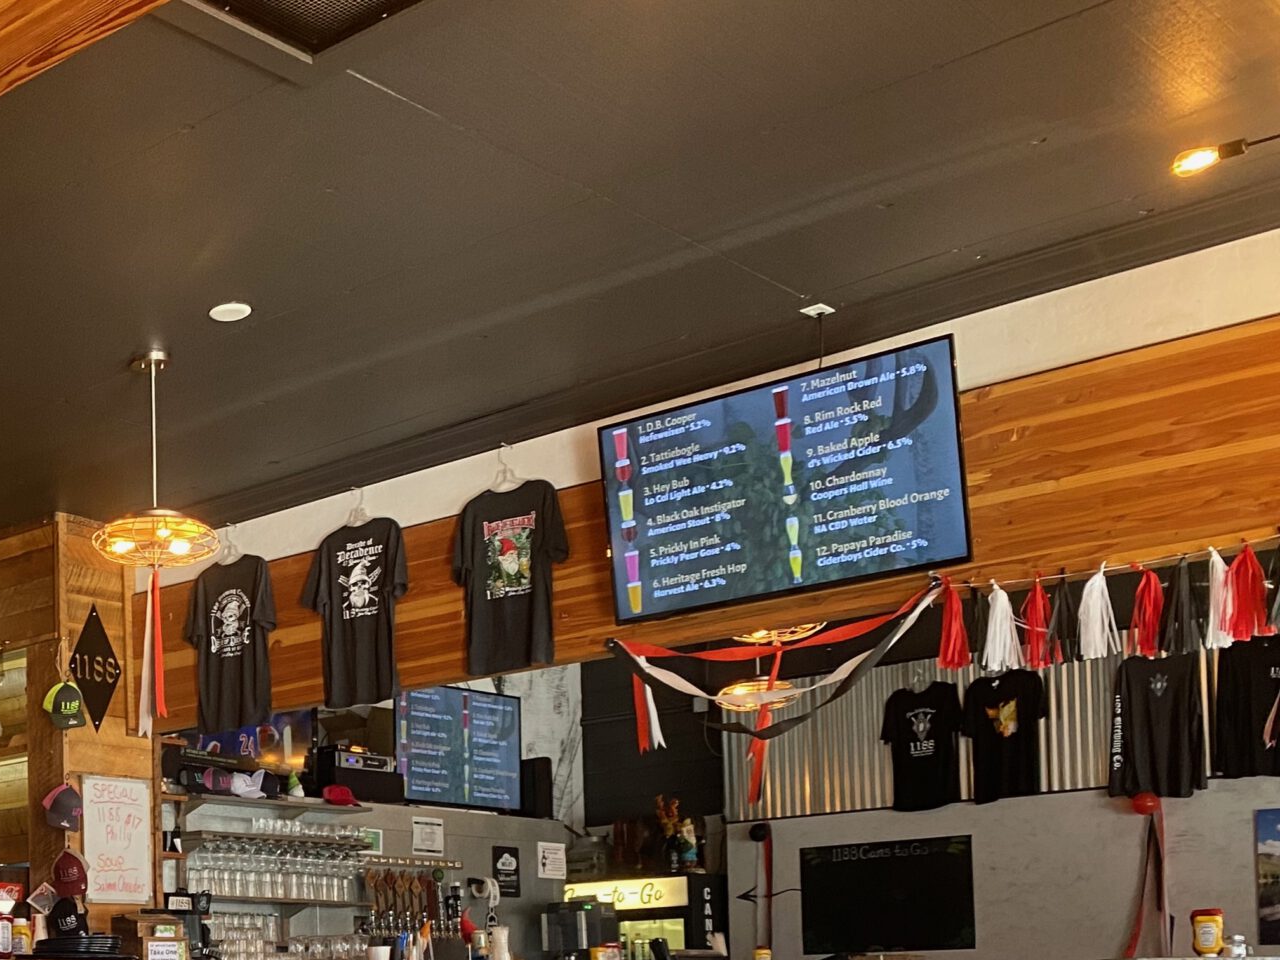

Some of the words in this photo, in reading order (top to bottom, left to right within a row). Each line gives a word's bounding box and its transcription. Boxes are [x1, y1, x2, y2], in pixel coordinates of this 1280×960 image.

[801, 383, 809, 391] 7.
[811, 370, 857, 389] Mazelnut
[802, 384, 845, 402] American
[847, 377, 878, 391] Brown
[880, 372, 895, 382] Ale
[900, 364, 927, 377] 5.8%
[804, 416, 813, 424] 8.
[815, 411, 835, 422] Rim
[836, 402, 862, 416] Rock
[862, 396, 882, 409] Red
[638, 426, 645, 434] 1.
[647, 420, 664, 431] D.B.
[665, 413, 696, 427] Cooper
[805, 424, 822, 436] Red
[824, 420, 839, 431] Ale
[844, 413, 868, 426] 5.5%
[641, 456, 649, 465] 2.
[650, 443, 700, 462] Tattiebogle
[806, 448, 815, 457] 9.
[817, 440, 848, 454] Baked
[850, 433, 880, 448] Apple
[821, 450, 855, 464] Wicked
[856, 443, 881, 457] Cider
[887, 437, 913, 450] 6.5%
[642, 460, 674, 475] Smoked
[676, 457, 692, 467] Wee
[693, 450, 719, 462] Heavy
[644, 487, 652, 496] 3.
[653, 483, 670, 494] Hey
[672, 477, 690, 488] Bub
[810, 480, 824, 490] 10.
[826, 467, 887, 486] Chardonnay
[811, 486, 848, 500] Coopers
[850, 482, 868, 492] Hall
[869, 477, 893, 488] Wine
[645, 498, 655, 506] Lo
[656, 494, 668, 503] Cal
[670, 490, 691, 500] Light
[692, 485, 706, 495] Ale
[813, 514, 825, 523] 11.
[826, 503, 877, 520] Cranberry
[879, 494, 908, 510] Blood
[910, 488, 950, 503] Orange
[656, 512, 680, 524] Black
[681, 507, 699, 519] Oak
[701, 499, 746, 514] Instigator
[648, 523, 686, 536] American
[688, 517, 711, 527] Stout
[814, 524, 827, 534] NA
[849, 514, 878, 526] Water
[336, 544, 383, 564] Decadence
[650, 549, 658, 557] 5.
[659, 542, 688, 555] Prickly
[690, 540, 699, 549] In
[700, 534, 720, 547] Pink
[651, 554, 678, 567] Prickly
[680, 551, 698, 561] Pear
[724, 542, 741, 551] 4%
[816, 546, 830, 556] 12.
[831, 539, 868, 554] Papaya
[869, 530, 913, 546] Paradise
[817, 551, 862, 566] Ciderboys
[863, 547, 888, 558] Cider
[890, 543, 905, 553] Co.
[911, 539, 928, 548] 5%
[653, 580, 661, 588] 6.
[662, 572, 700, 586] Heritage
[701, 565, 726, 579] Fresh
[727, 563, 746, 574] Hop
[654, 585, 685, 597] Harvest
[686, 582, 699, 591] Ale
[75, 653, 116, 683] 1188
[98, 853, 124, 868] Soup
[859, 846, 890, 860] Cans
[910, 843, 929, 855] Go
